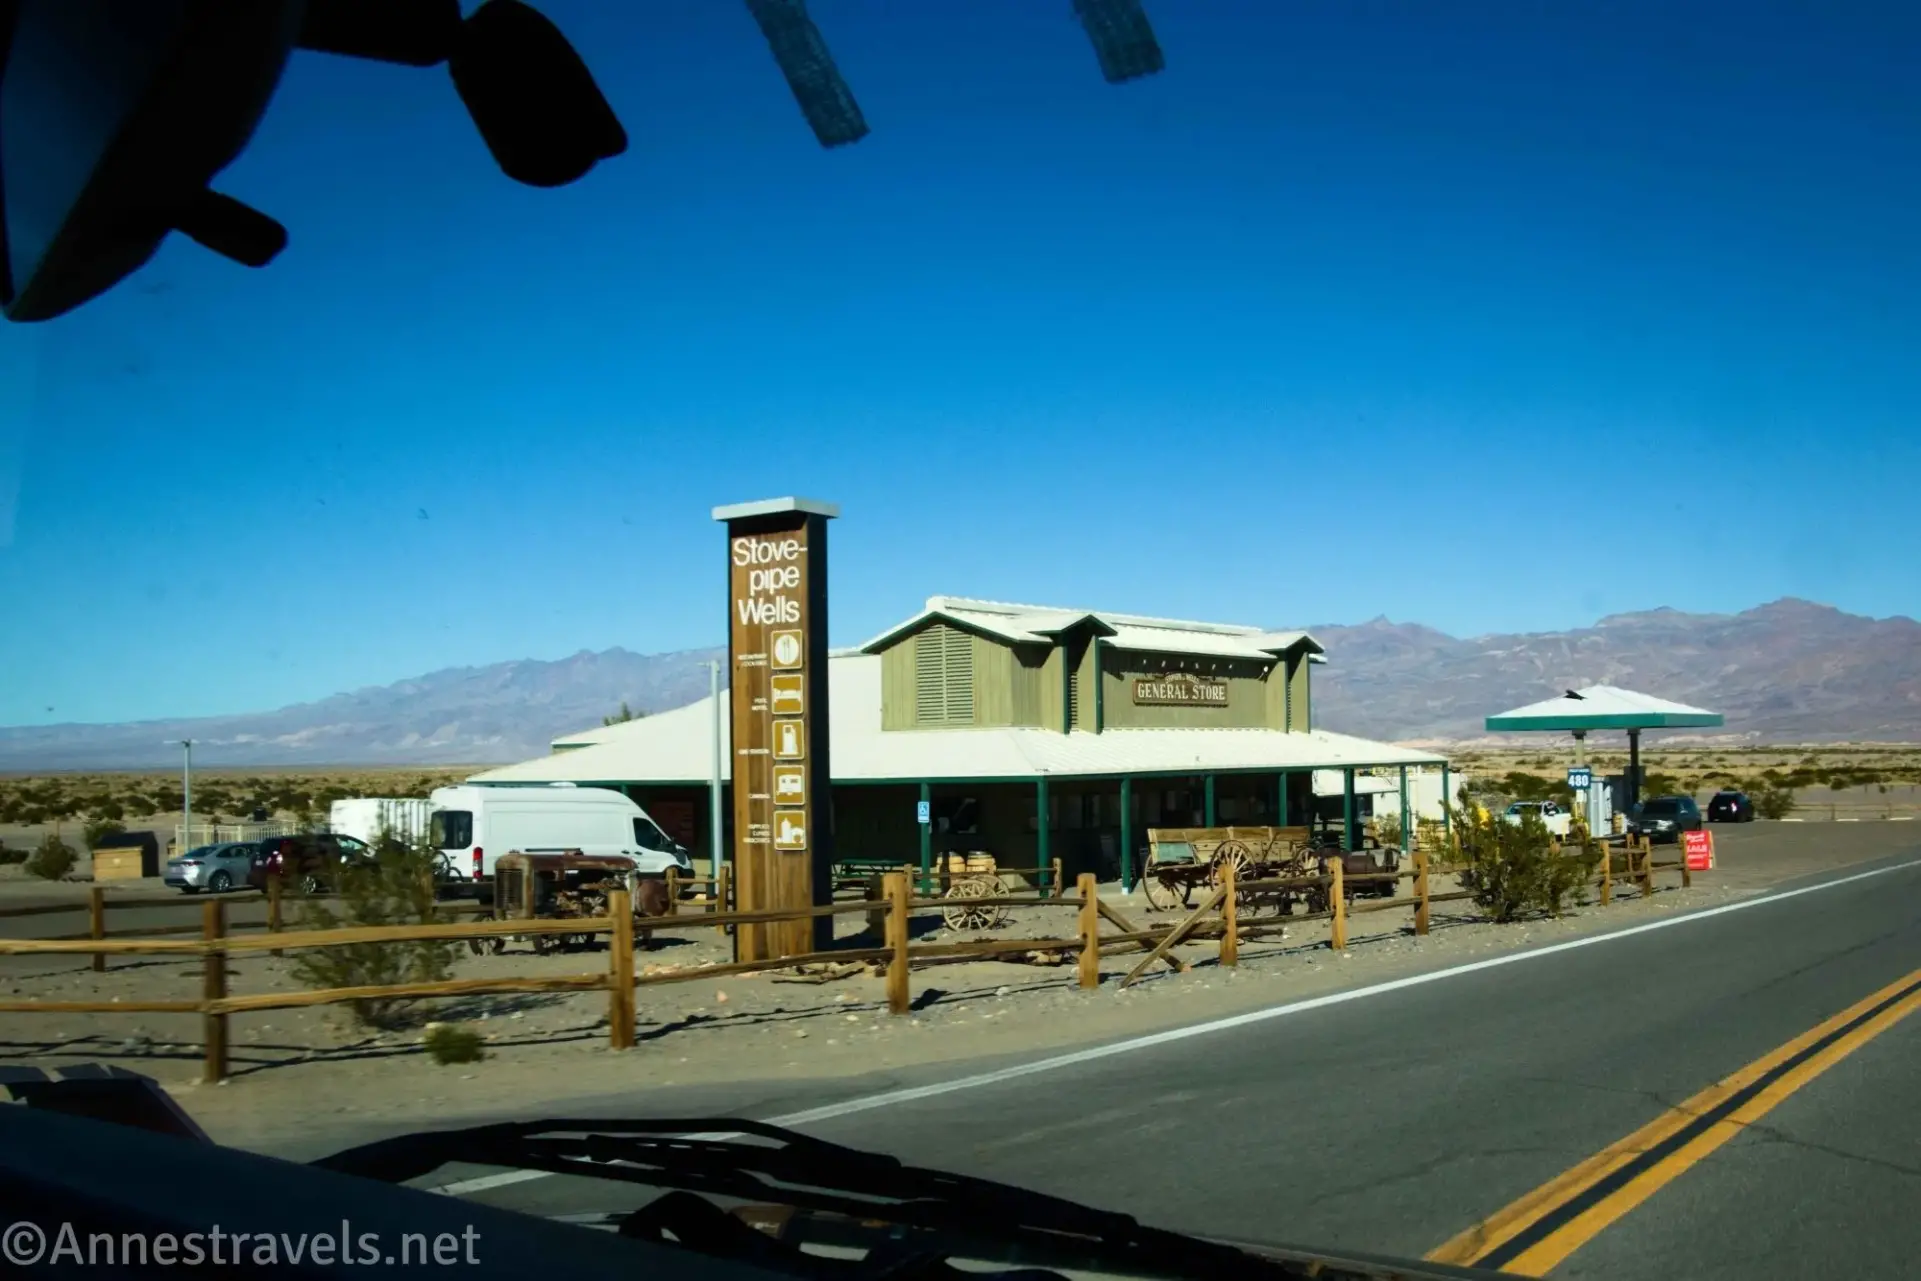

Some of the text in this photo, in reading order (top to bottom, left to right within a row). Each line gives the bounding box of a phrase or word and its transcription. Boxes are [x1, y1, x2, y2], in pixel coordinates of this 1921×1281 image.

[734, 538, 808, 566] Stove-
[750, 566, 800, 596] pipe
[738, 596, 800, 625] Wells
[1137, 683, 1225, 700] GENERAL STORE
